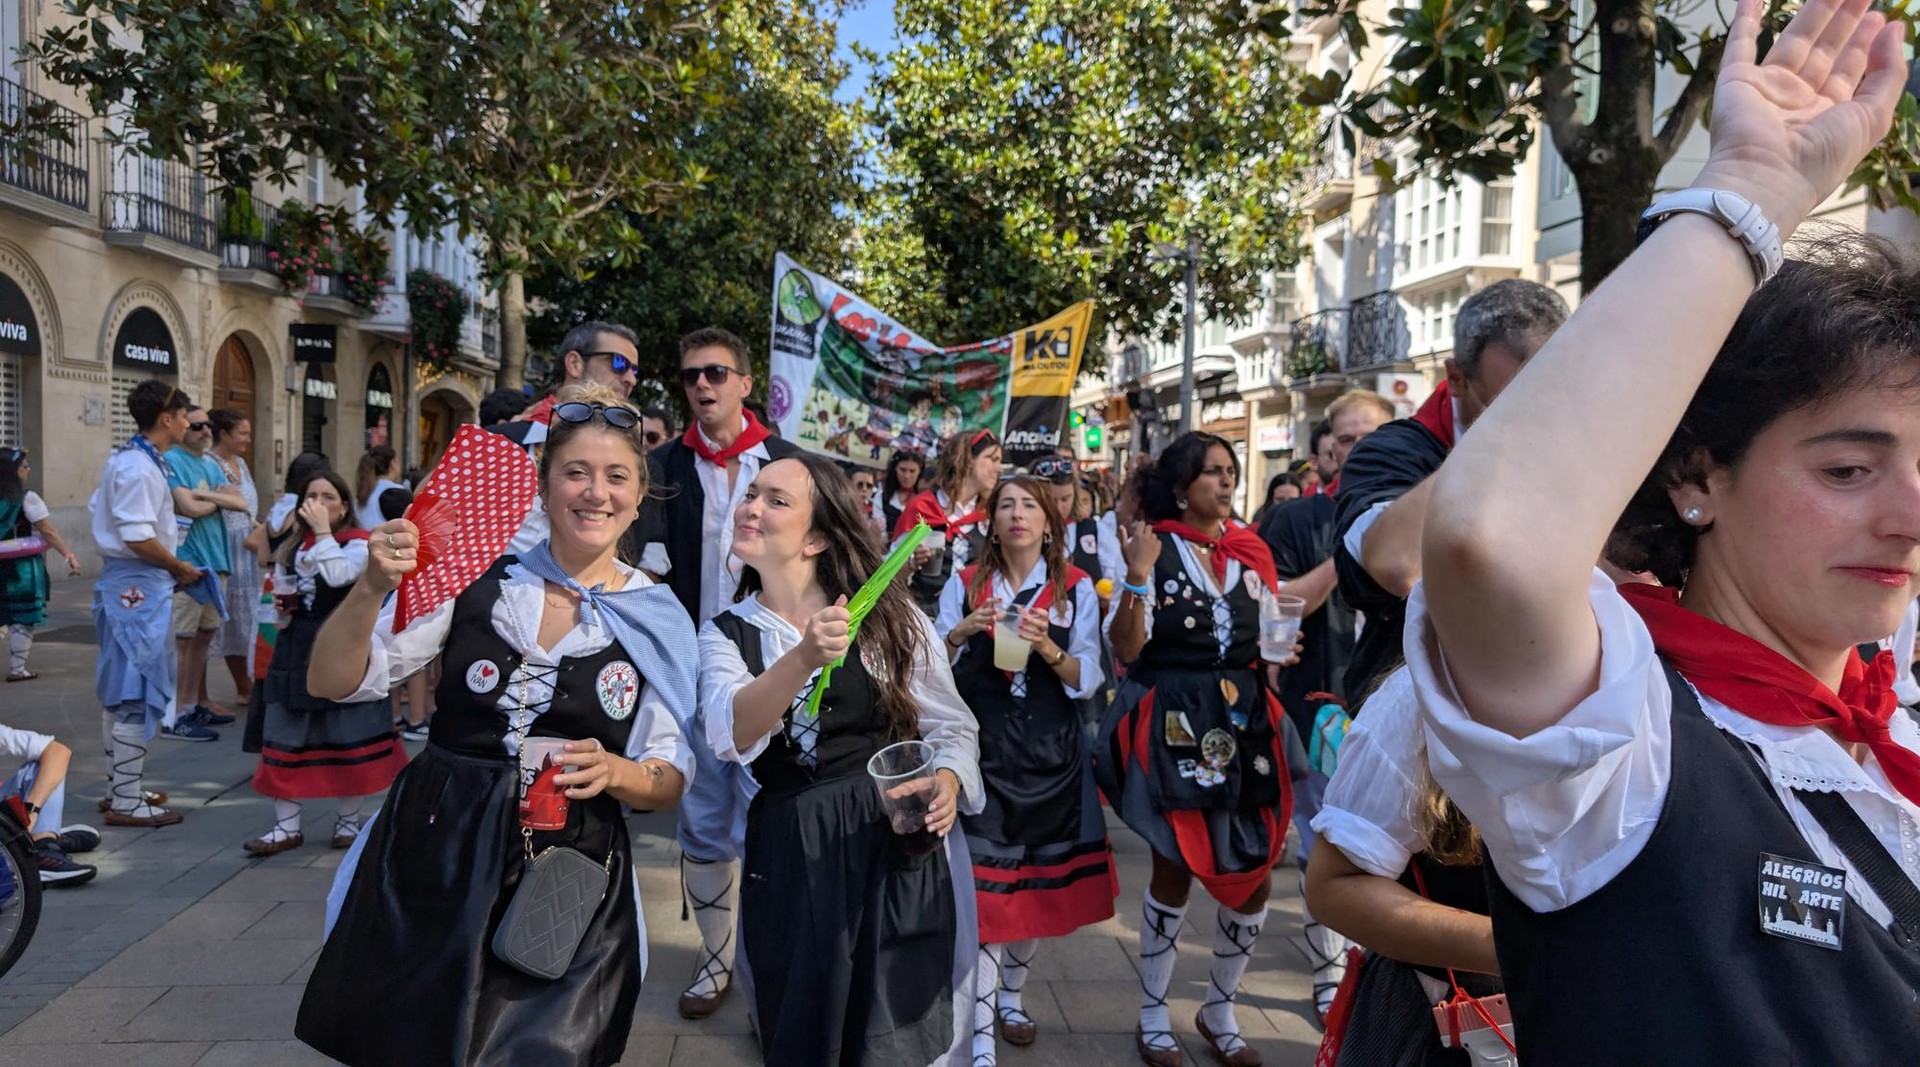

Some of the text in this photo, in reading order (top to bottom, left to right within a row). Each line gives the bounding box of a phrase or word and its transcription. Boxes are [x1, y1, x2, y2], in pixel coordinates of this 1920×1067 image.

[125, 344, 170, 364] casa viva
[476, 663, 483, 672] I
[470, 673, 488, 689] IVAN
[1762, 861, 1843, 889] ALEGRIOS
[1762, 882, 1842, 910] HIL ARTE
